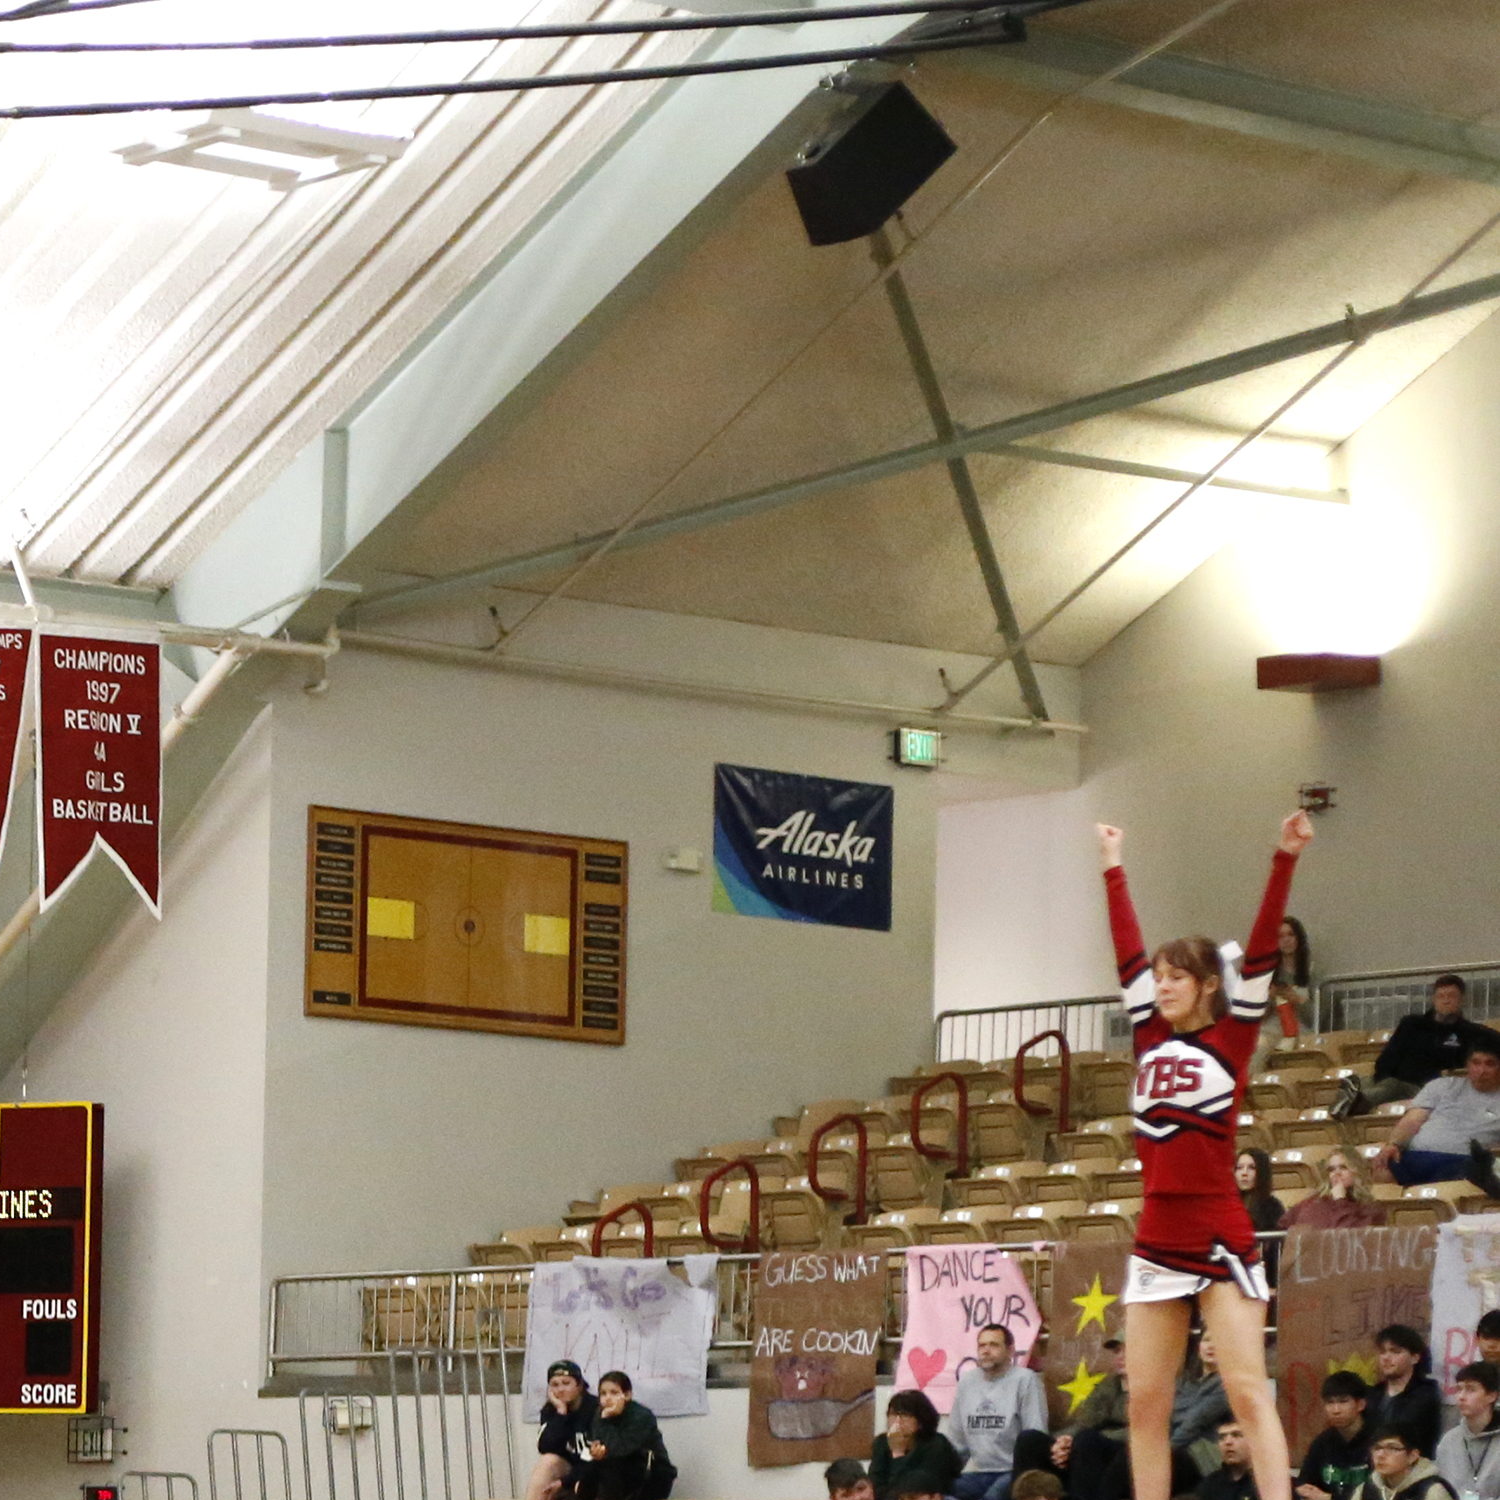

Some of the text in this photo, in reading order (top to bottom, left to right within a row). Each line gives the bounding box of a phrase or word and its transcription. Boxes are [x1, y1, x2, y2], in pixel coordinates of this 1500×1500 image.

[55, 649, 145, 674] CHAMPIONS
[87, 681, 120, 703] 1997
[65, 710, 141, 734] REGION V
[756, 811, 875, 865] Alaska
[763, 863, 863, 889] AIRLINES
[765, 1254, 880, 1287] GUESS WHAT
[920, 1250, 1000, 1291] DANCE
[23, 1300, 76, 1319] FOULS
[961, 1295, 1030, 1332] YOUR
[755, 1329, 794, 1356] ARE
[22, 1384, 76, 1403] SCORE
